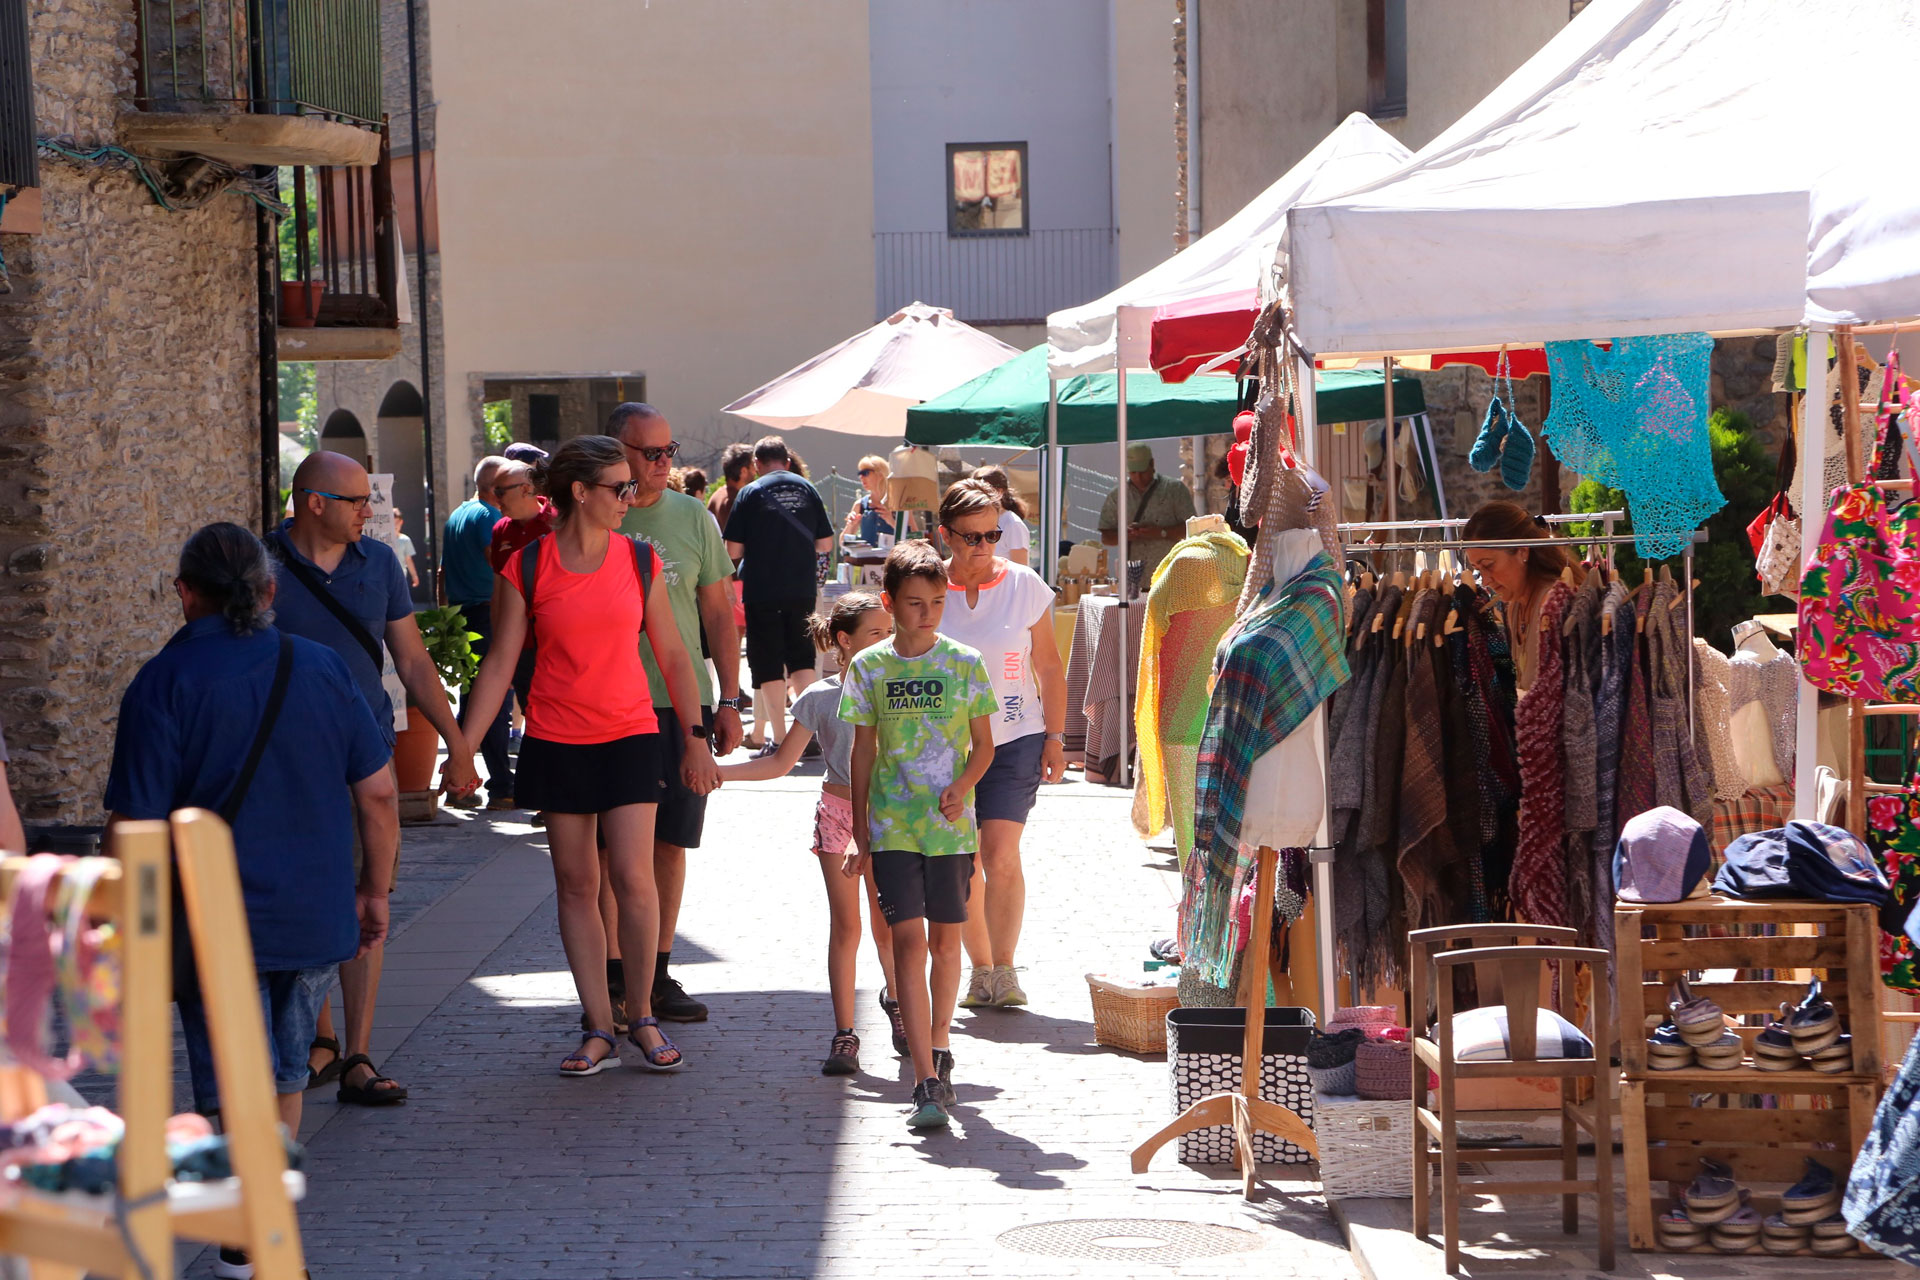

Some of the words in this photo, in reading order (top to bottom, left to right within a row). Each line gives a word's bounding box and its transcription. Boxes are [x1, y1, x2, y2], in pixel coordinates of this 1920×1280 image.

[1003, 652, 1020, 680] FUN
[886, 680, 944, 698] ECO
[888, 697, 942, 710] MANIAC
[1003, 695, 1020, 723] RUN
